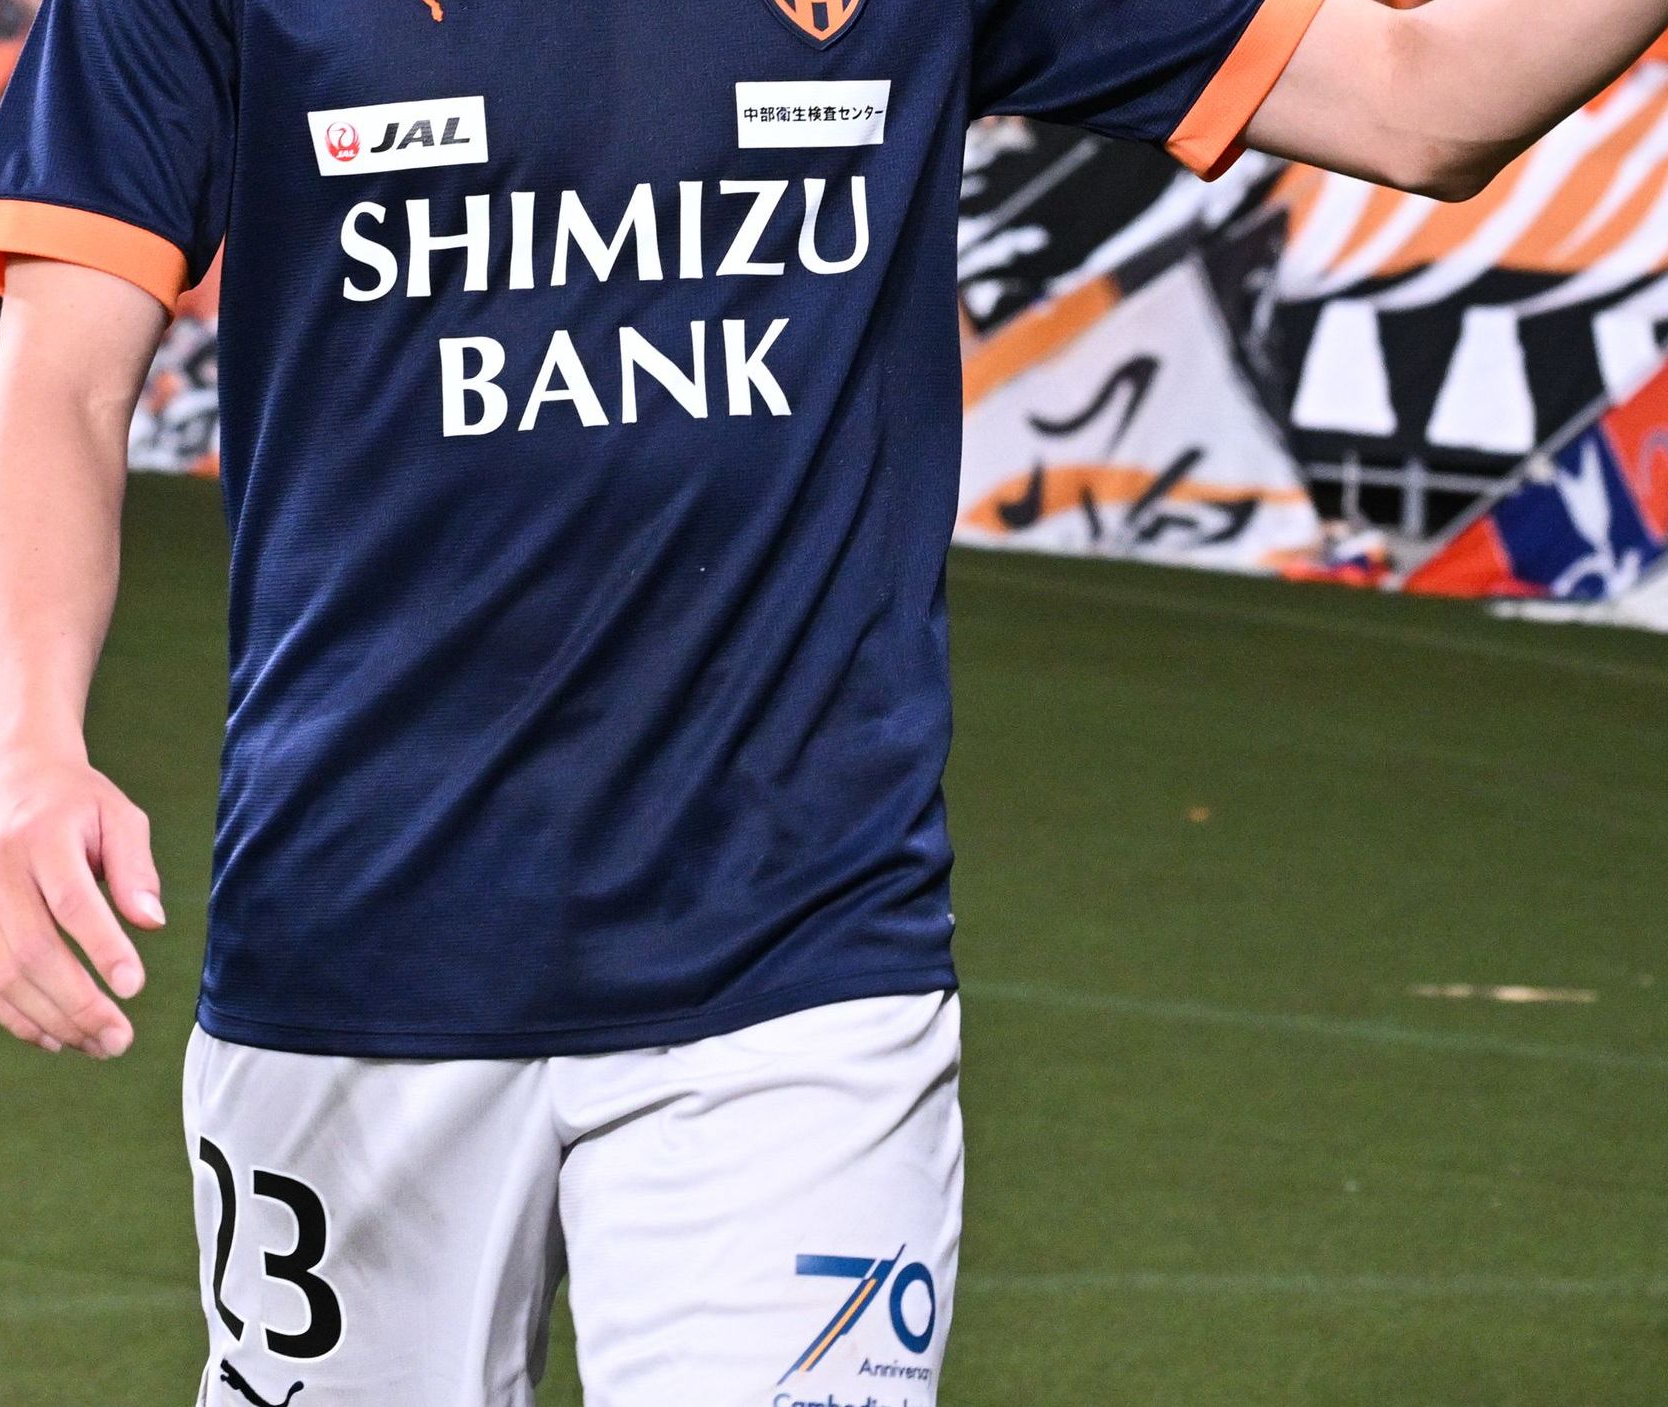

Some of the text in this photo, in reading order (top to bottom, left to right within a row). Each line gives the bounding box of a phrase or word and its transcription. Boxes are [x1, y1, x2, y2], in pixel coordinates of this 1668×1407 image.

[370, 116, 471, 154] JAL
[743, 104, 884, 123] 中部衛生検査センター
[340, 175, 870, 302] SHIMIZU
[438, 317, 793, 438] BANK
[776, 1243, 936, 1386] 70
